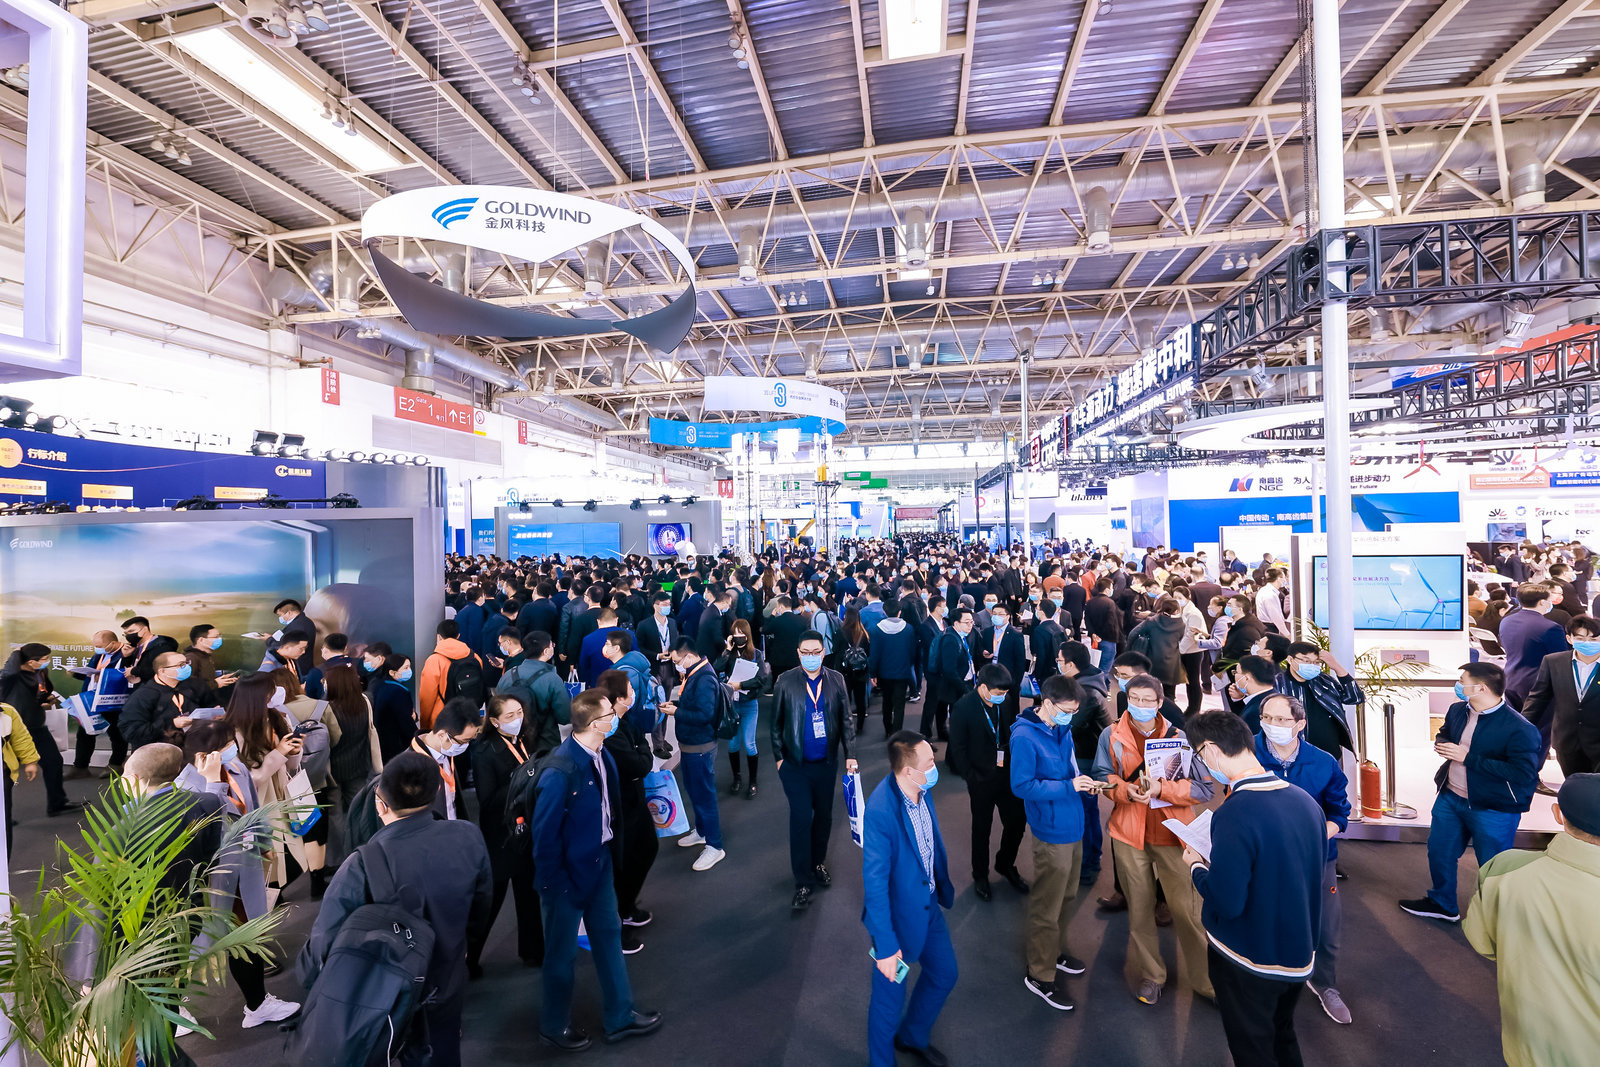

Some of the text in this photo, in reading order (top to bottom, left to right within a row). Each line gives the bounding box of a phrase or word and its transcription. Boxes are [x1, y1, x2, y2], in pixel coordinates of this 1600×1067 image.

[484, 200, 592, 225] GOLDWIND
[485, 216, 547, 234] 金风科技
[1166, 376, 1195, 401] FUTURE
[399, 396, 415, 413] E2
[416, 396, 427, 404] Gate
[428, 403, 433, 417] 1
[459, 411, 471, 426] E1
[1239, 514, 1270, 522] 中国传动
[19, 540, 53, 549] GOLDWIND
